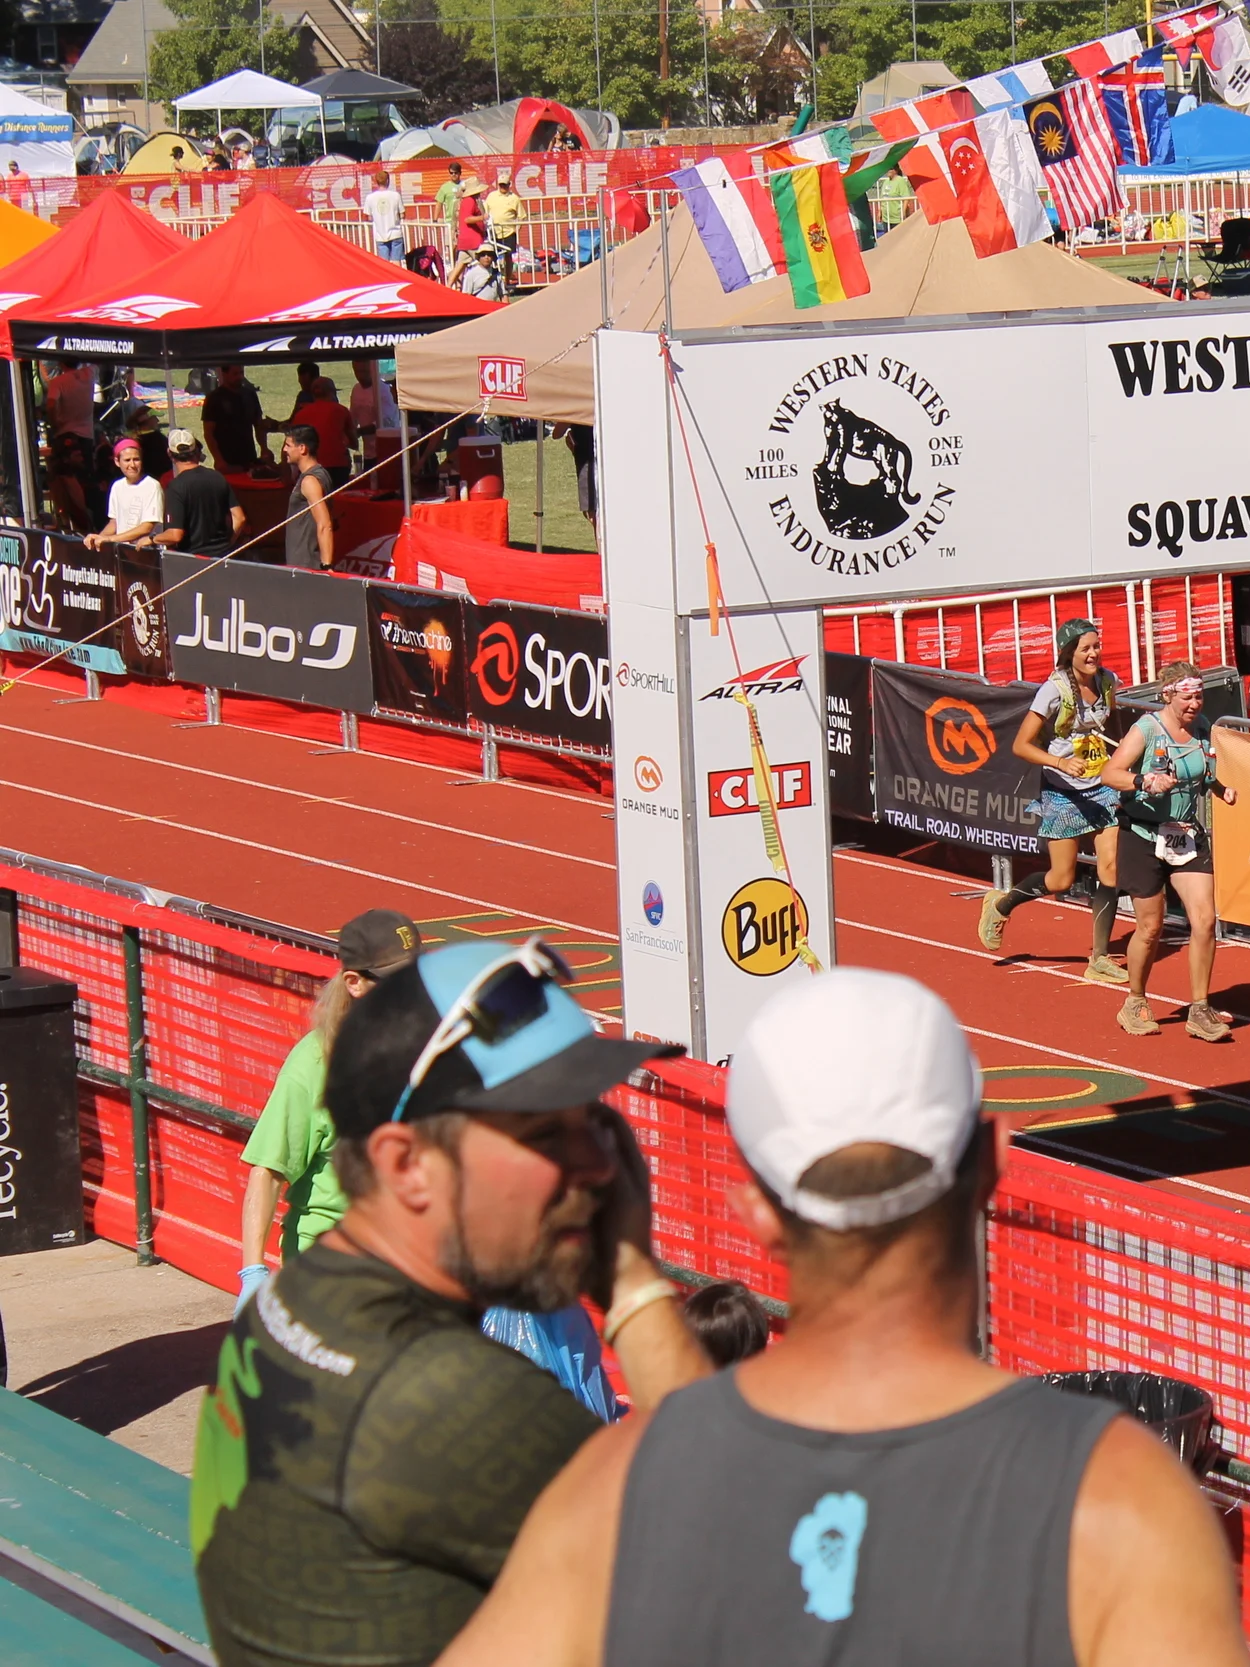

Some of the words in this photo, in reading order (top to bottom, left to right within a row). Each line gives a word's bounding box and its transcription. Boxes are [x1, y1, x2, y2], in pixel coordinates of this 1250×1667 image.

[4, 121, 37, 132] Distance
[38, 122, 70, 133] Runners
[517, 161, 609, 198] CLIF
[149, 183, 240, 219] CLIF
[62, 337, 135, 355] ALTRARUNNING.COM
[483, 361, 524, 394] CLIF
[768, 353, 869, 436] WESTERN
[877, 356, 951, 427] STATES
[758, 448, 785, 463] 100
[928, 435, 964, 451] ONE
[744, 463, 799, 481] MILES
[930, 451, 963, 468] DAY
[768, 493, 917, 576] ENDURANCE
[912, 481, 957, 546] RUN
[175, 592, 296, 663] Julbo
[630, 668, 676, 695] SPORTHILL
[697, 678, 804, 702] ALTRA
[622, 798, 658, 816] ORANGE
[659, 805, 680, 821] MUD
[893, 774, 979, 816] ORANGE
[985, 791, 1037, 825] MUD
[884, 809, 925, 832] TRAIL.
[926, 817, 963, 840] ROAD.
[964, 825, 1040, 854] WHEREVER.
[1165, 833, 1188, 849] 204
[625, 927, 685, 955] SanFranciscoVC
